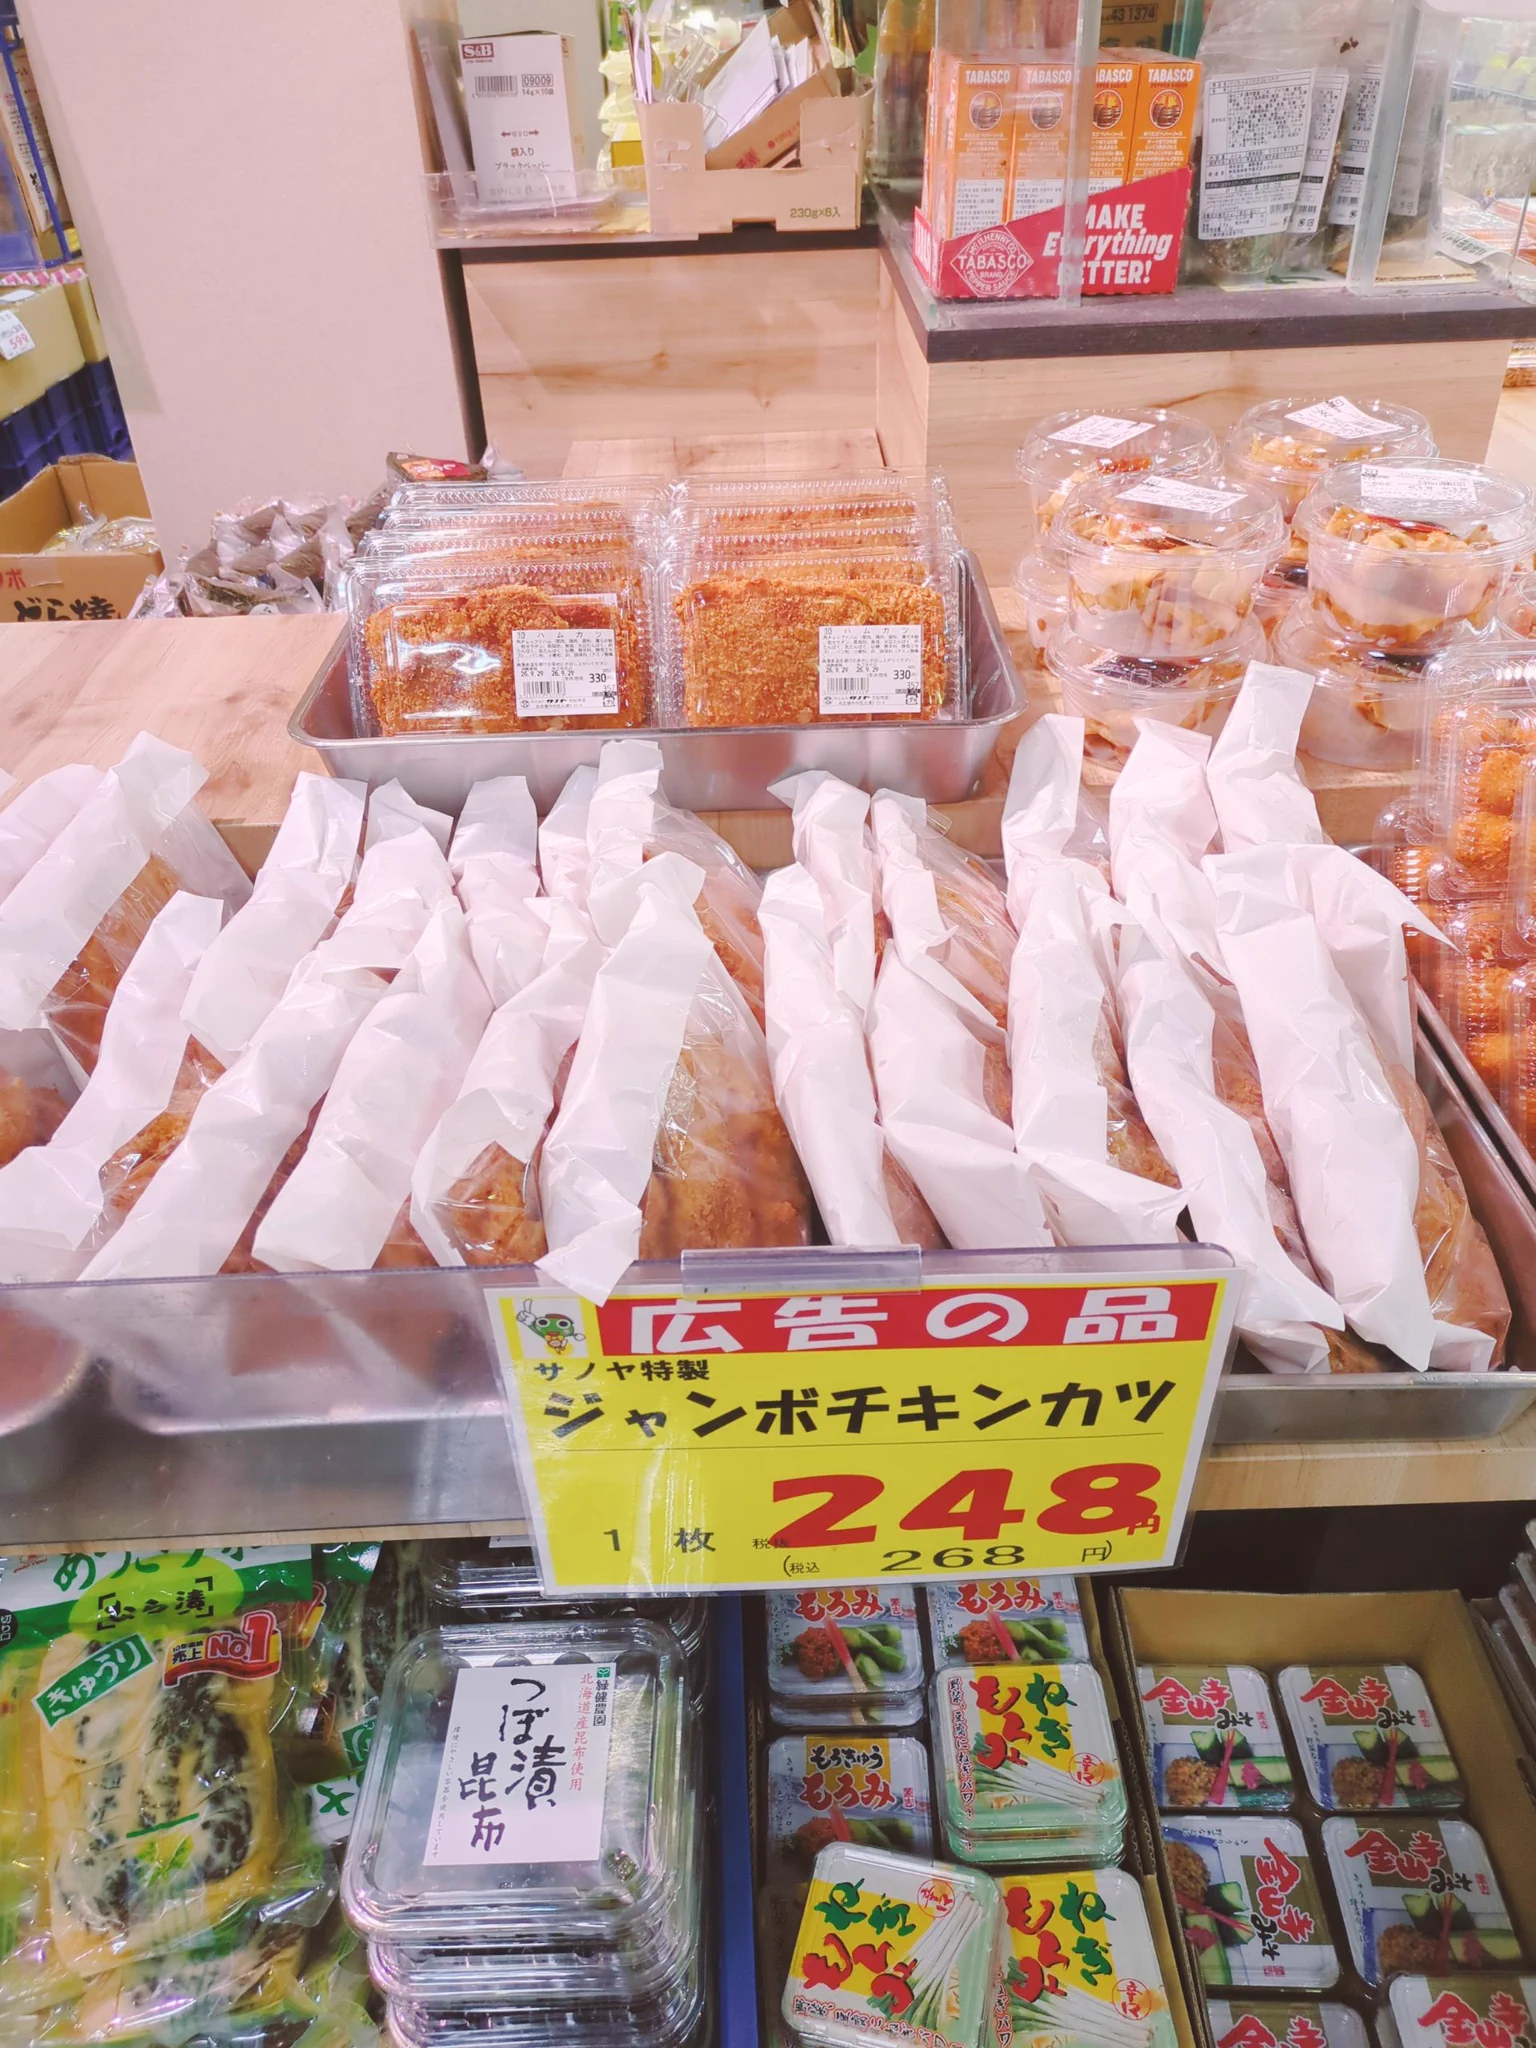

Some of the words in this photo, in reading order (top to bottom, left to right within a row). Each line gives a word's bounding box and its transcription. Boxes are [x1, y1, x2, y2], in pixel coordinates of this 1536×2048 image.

[463, 45, 493, 58] S&B
[523, 75, 552, 87] 09009
[964, 69, 1011, 84] TABASCO
[1026, 69, 1072, 84] TABASCO
[1147, 68, 1195, 83] TABASCO
[966, 269, 992, 292] PEPPER
[992, 269, 1016, 292] SAUCE
[979, 271, 1003, 279] BRAND
[589, 673, 607, 683] 330
[893, 669, 911, 680] 330
[630, 1287, 1178, 1353] 広告の品
[534, 1359, 710, 1382] サノヤ特製
[543, 1379, 1177, 1439] ジャンボチキンカツ
[673, 1527, 717, 1554] 枚
[880, 1545, 1025, 1572] 268
[794, 1588, 885, 1622] もろみ
[956, 1580, 1047, 1615] もろみ
[172, 1647, 203, 1665] 売上
[206, 1612, 270, 1664] No.1
[46, 1640, 141, 1717] きゅうり
[569, 1672, 594, 1792] 北海道産昆布使用
[1024, 1672, 1078, 1758] ねぎ
[499, 1677, 567, 1811] つぼ漬
[809, 1744, 884, 1771] もろきゅう
[458, 1751, 506, 1852] 昆布
[799, 1771, 897, 1811] もろみ
[813, 1876, 917, 1937] ねぎ
[1058, 1879, 1117, 1987] ねぎ
[1216, 2014, 1327, 2048] 金寺
